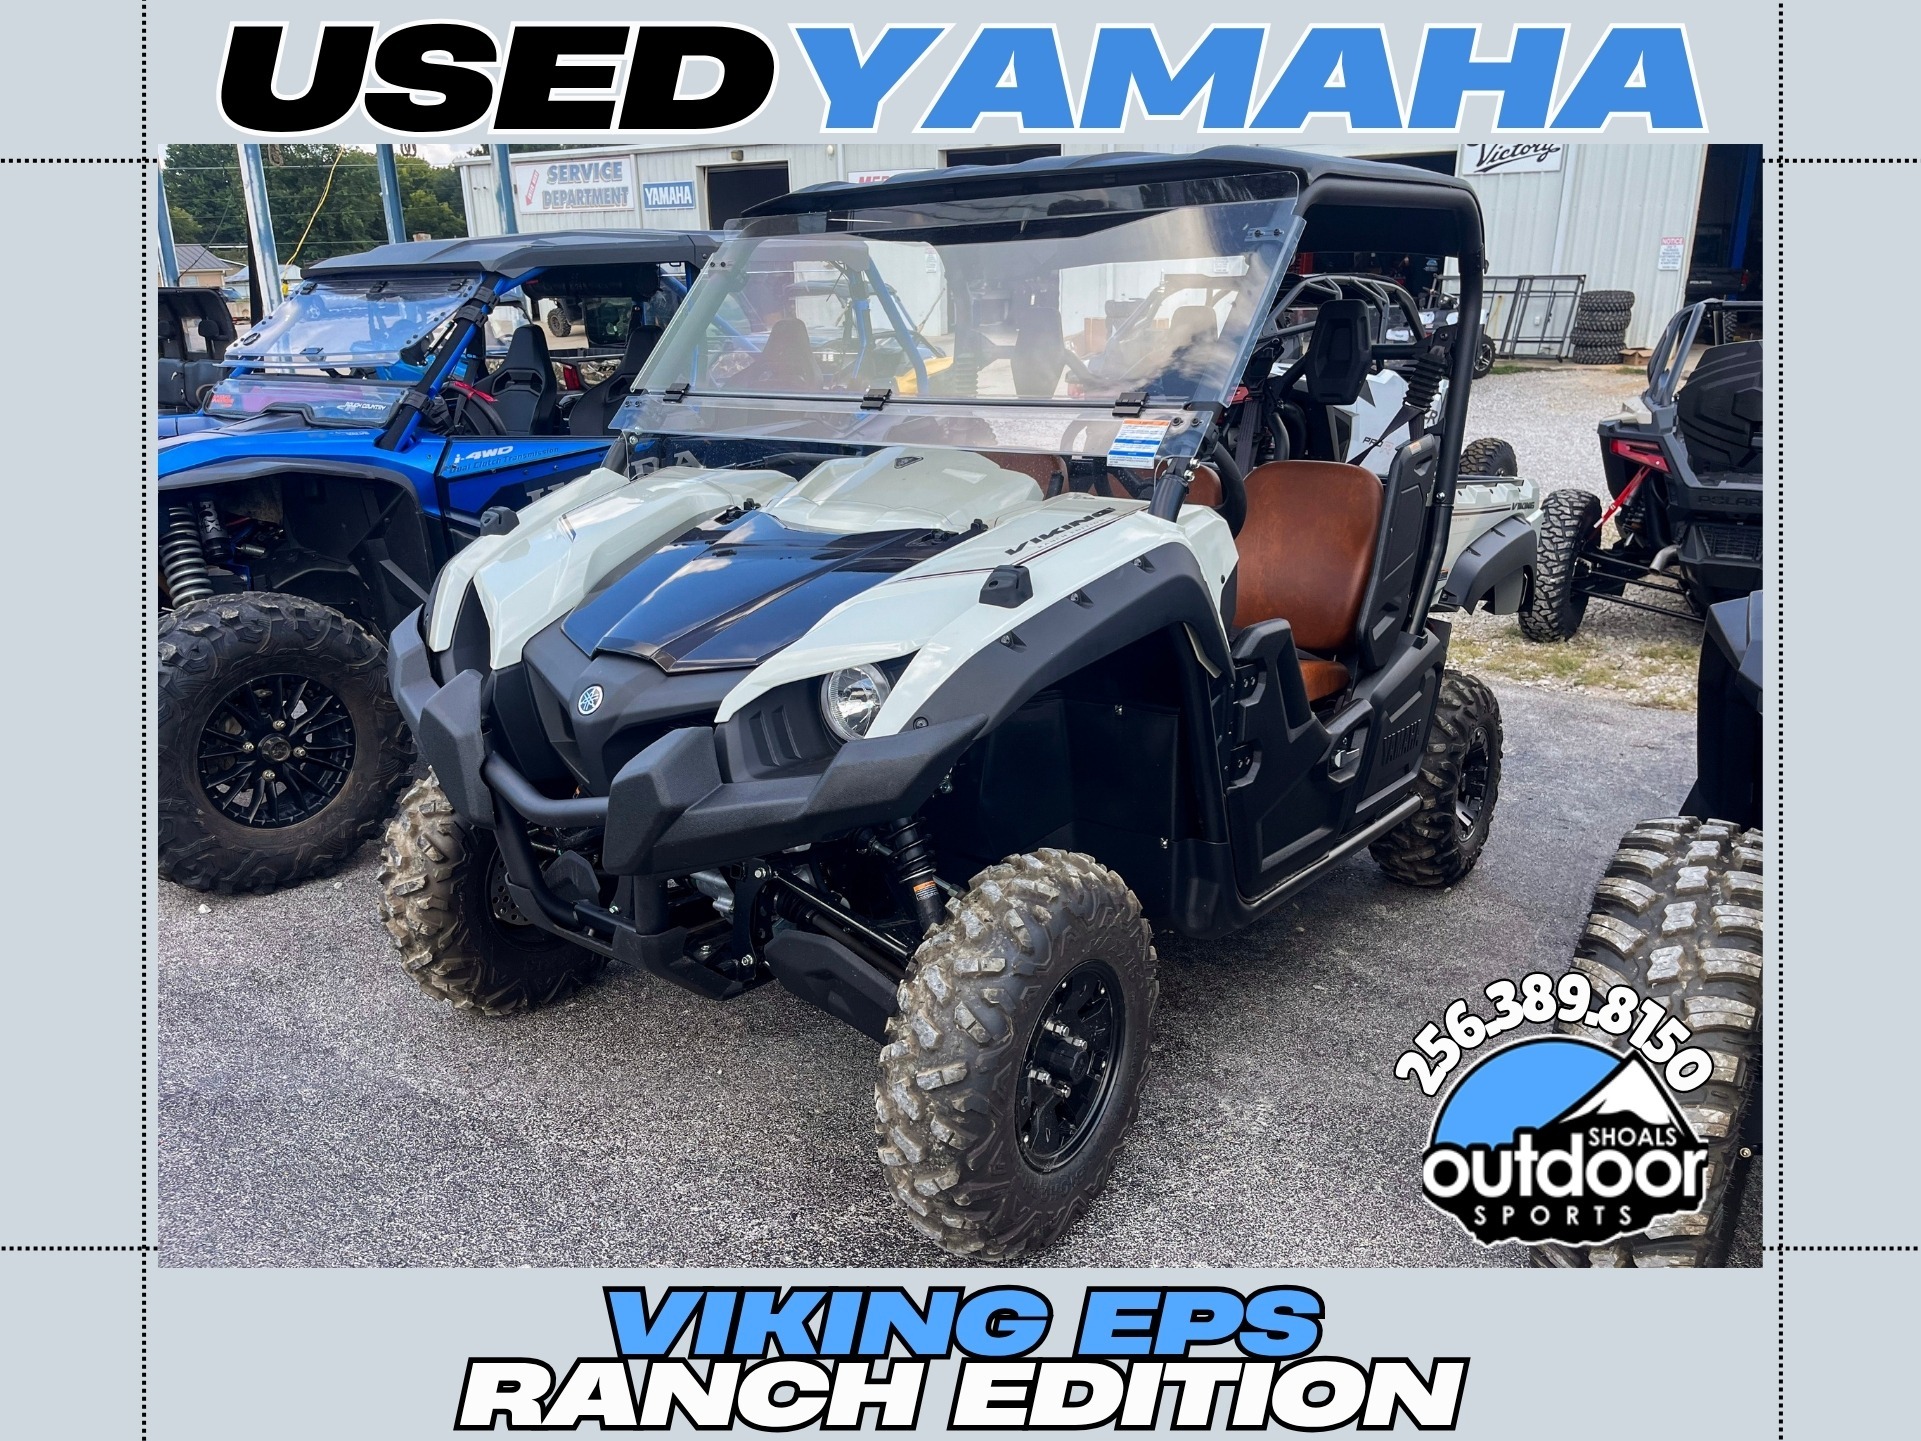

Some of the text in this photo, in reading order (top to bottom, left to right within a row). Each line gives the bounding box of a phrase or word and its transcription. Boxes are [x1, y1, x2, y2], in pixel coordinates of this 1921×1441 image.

[1476, 144, 1561, 167] Victory
[546, 161, 623, 185] SERVICE
[542, 186, 629, 210] DEPARTMENT
[644, 186, 693, 206] YAMAHA
[361, 403, 387, 411] COUNTRY
[453, 445, 514, 464] i-4WD
[473, 459, 502, 470] Clutch
[503, 447, 560, 463] Transmission
[200, 501, 221, 534] FOX
[1511, 501, 1535, 511] VIKING
[1004, 507, 1116, 555] VIKING
